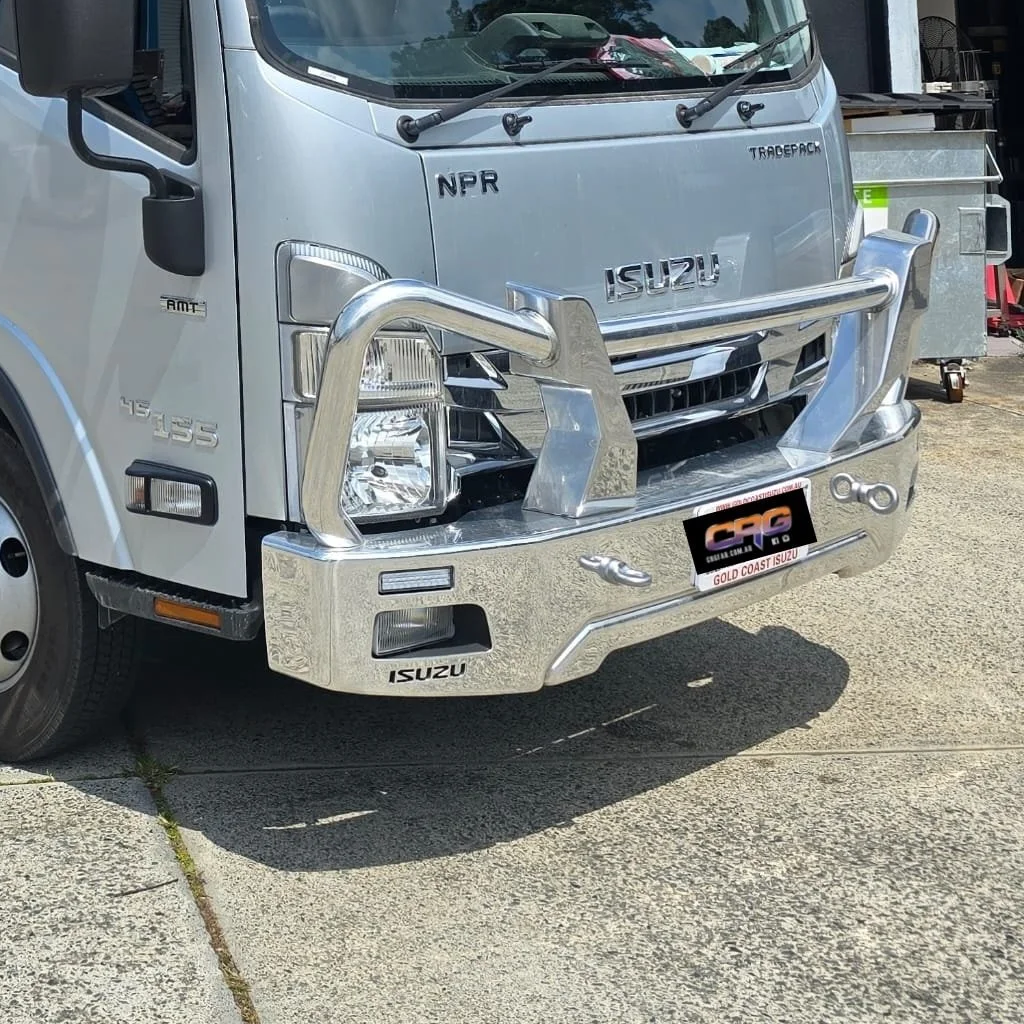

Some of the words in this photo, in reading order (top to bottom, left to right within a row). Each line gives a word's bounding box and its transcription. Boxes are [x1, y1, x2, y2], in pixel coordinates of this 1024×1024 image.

[749, 140, 822, 161] TRADEPACK
[437, 169, 500, 199] NPR
[604, 251, 720, 304] ISUZU
[166, 299, 199, 314] AMT
[120, 395, 151, 418] 45
[153, 411, 220, 448] 155
[713, 568, 739, 586] GOLD
[741, 557, 771, 578] COAST
[772, 548, 800, 566] ISUZU
[388, 663, 466, 684] ISUZU
